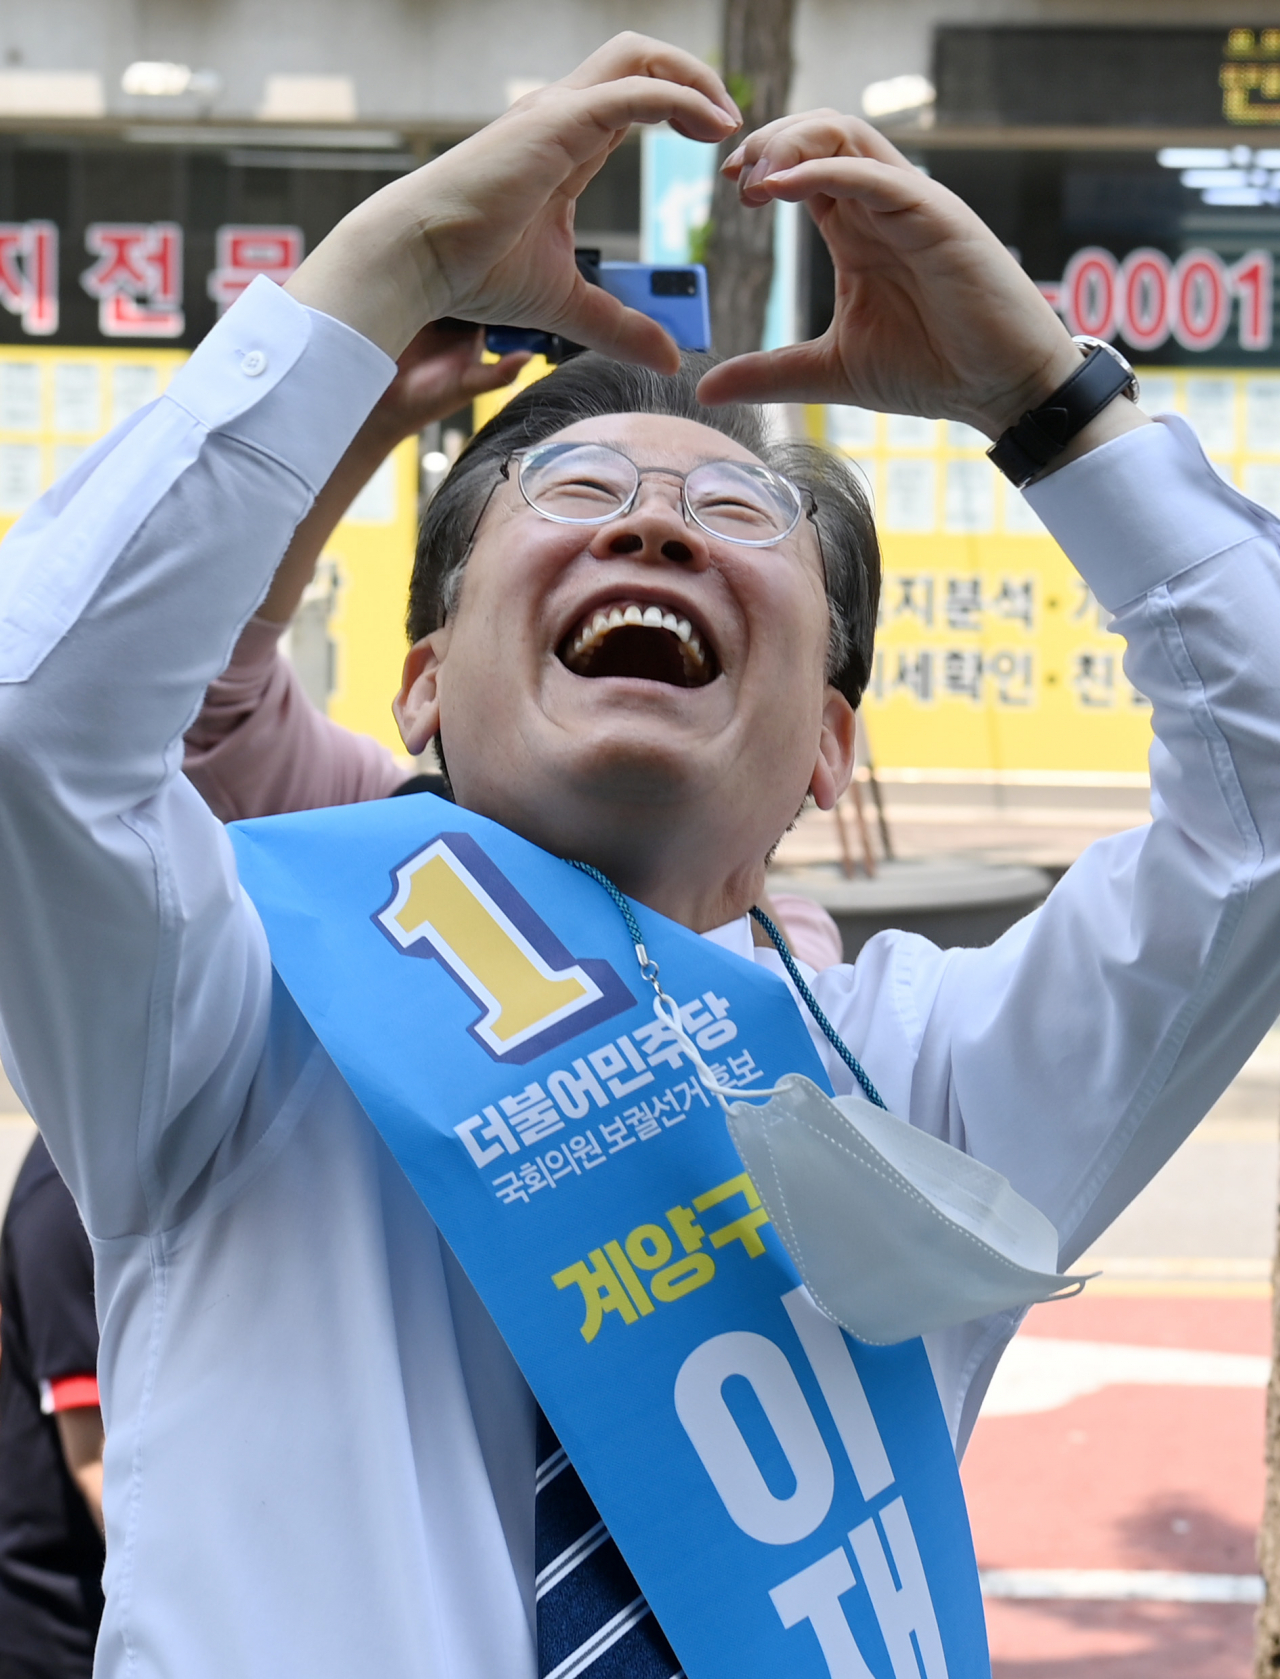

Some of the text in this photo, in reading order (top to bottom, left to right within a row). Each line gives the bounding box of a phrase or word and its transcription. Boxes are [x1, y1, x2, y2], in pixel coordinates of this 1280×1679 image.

[877, 575, 1034, 630] 지분석
[373, 836, 620, 1062] 1
[453, 990, 738, 1169] 더불어민주당
[491, 1131, 606, 1205] 국회의원
[598, 1075, 711, 1156] 보궐선거
[551, 1172, 771, 1344] 계양구
